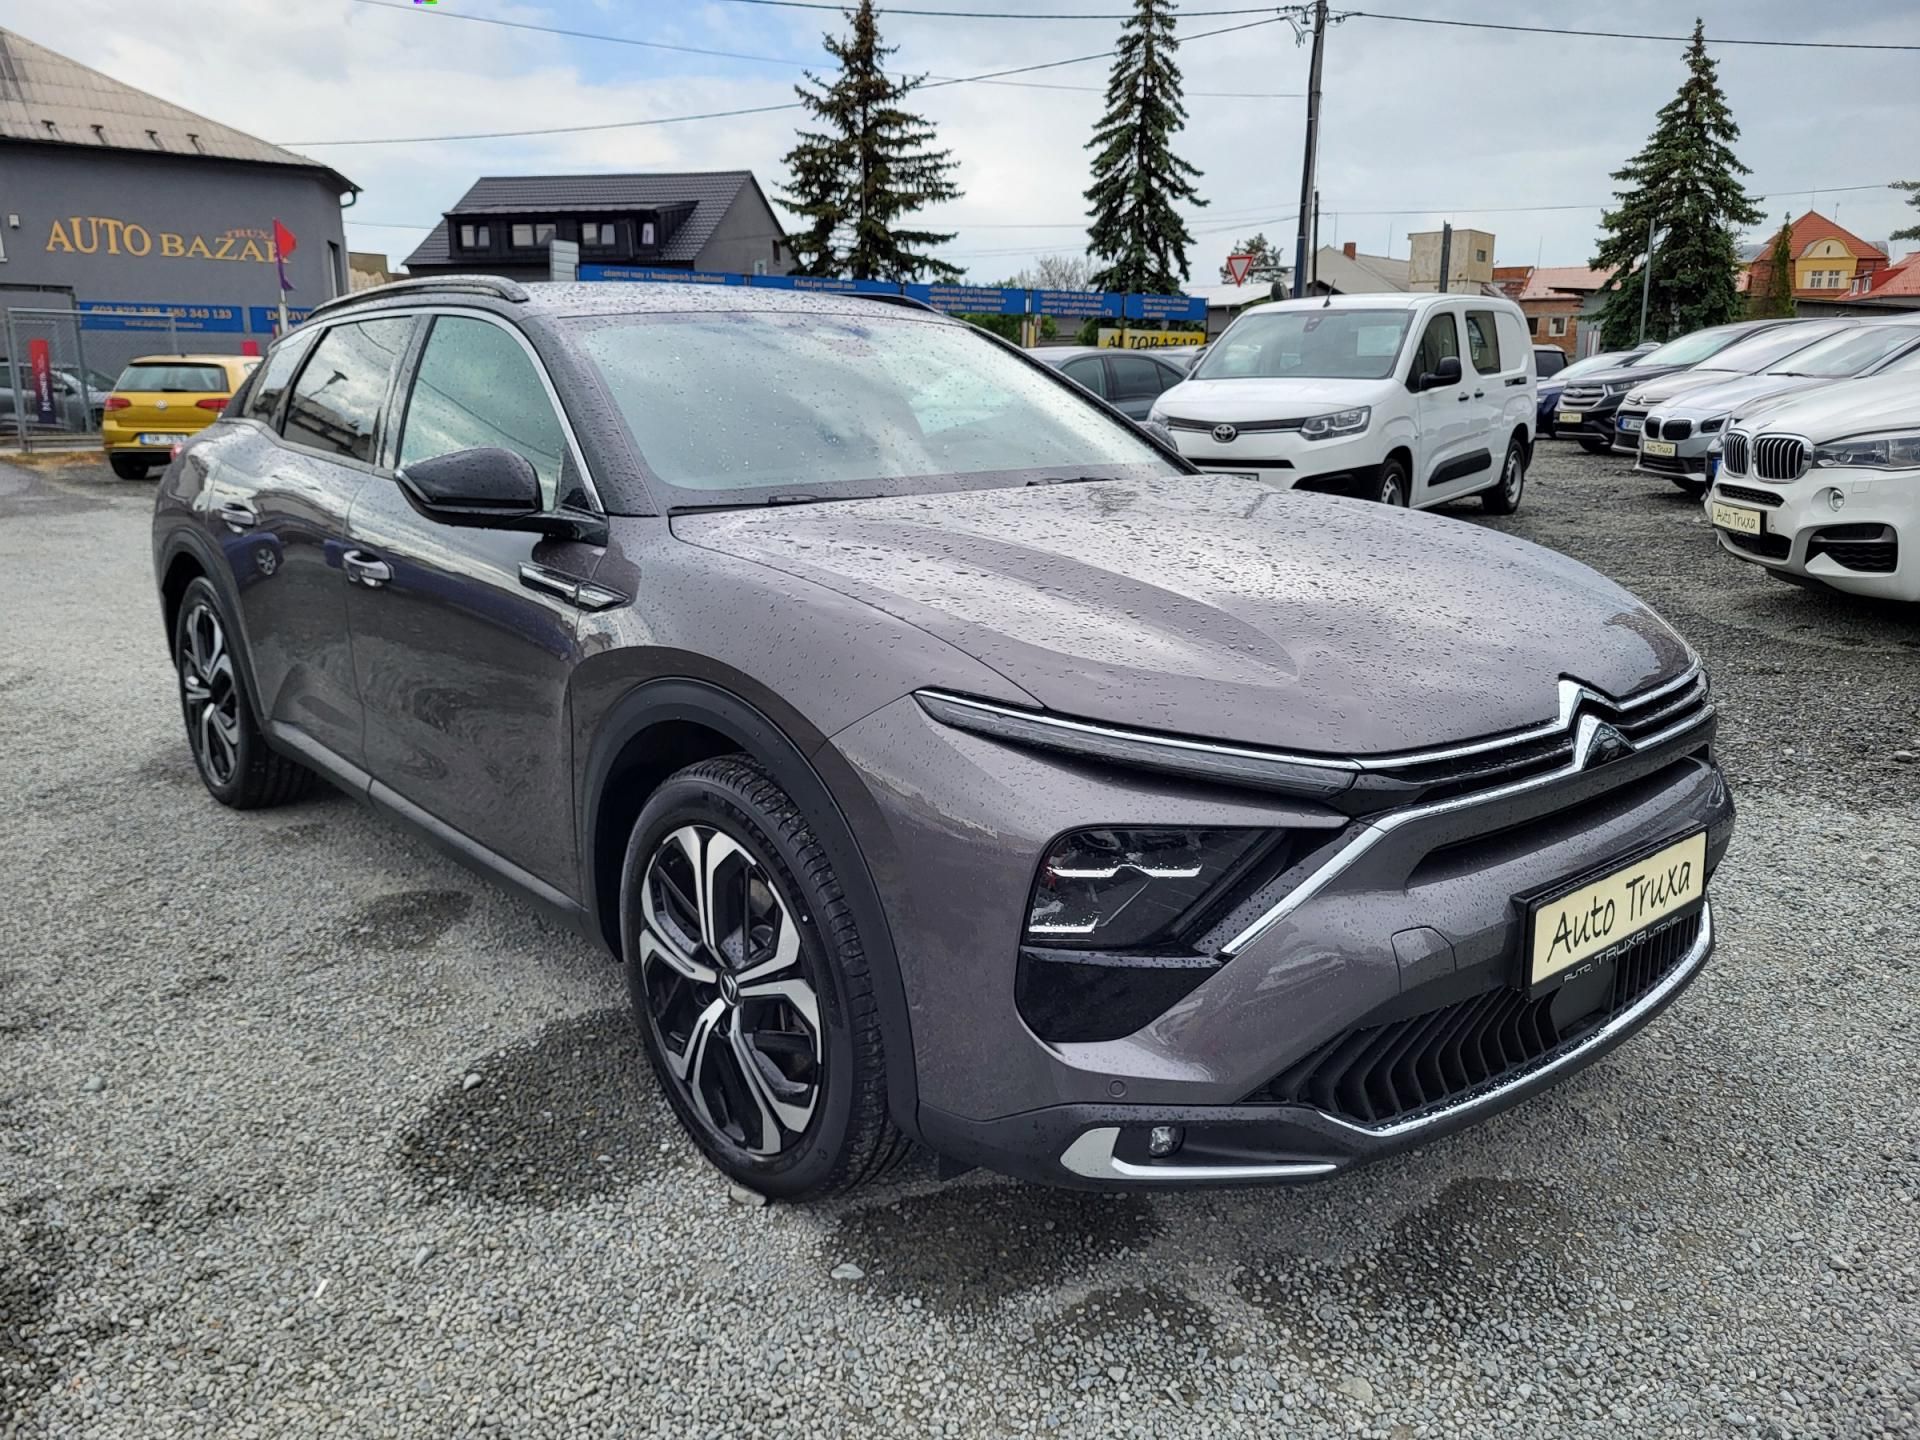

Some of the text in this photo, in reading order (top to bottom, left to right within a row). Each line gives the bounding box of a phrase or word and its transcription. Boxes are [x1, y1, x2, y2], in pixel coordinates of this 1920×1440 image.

[47, 217, 151, 256] AUTO
[1733, 512, 1756, 529] Truxa
[1547, 861, 1691, 963] Auto Truxa
[1594, 930, 1648, 964] TRUXA
